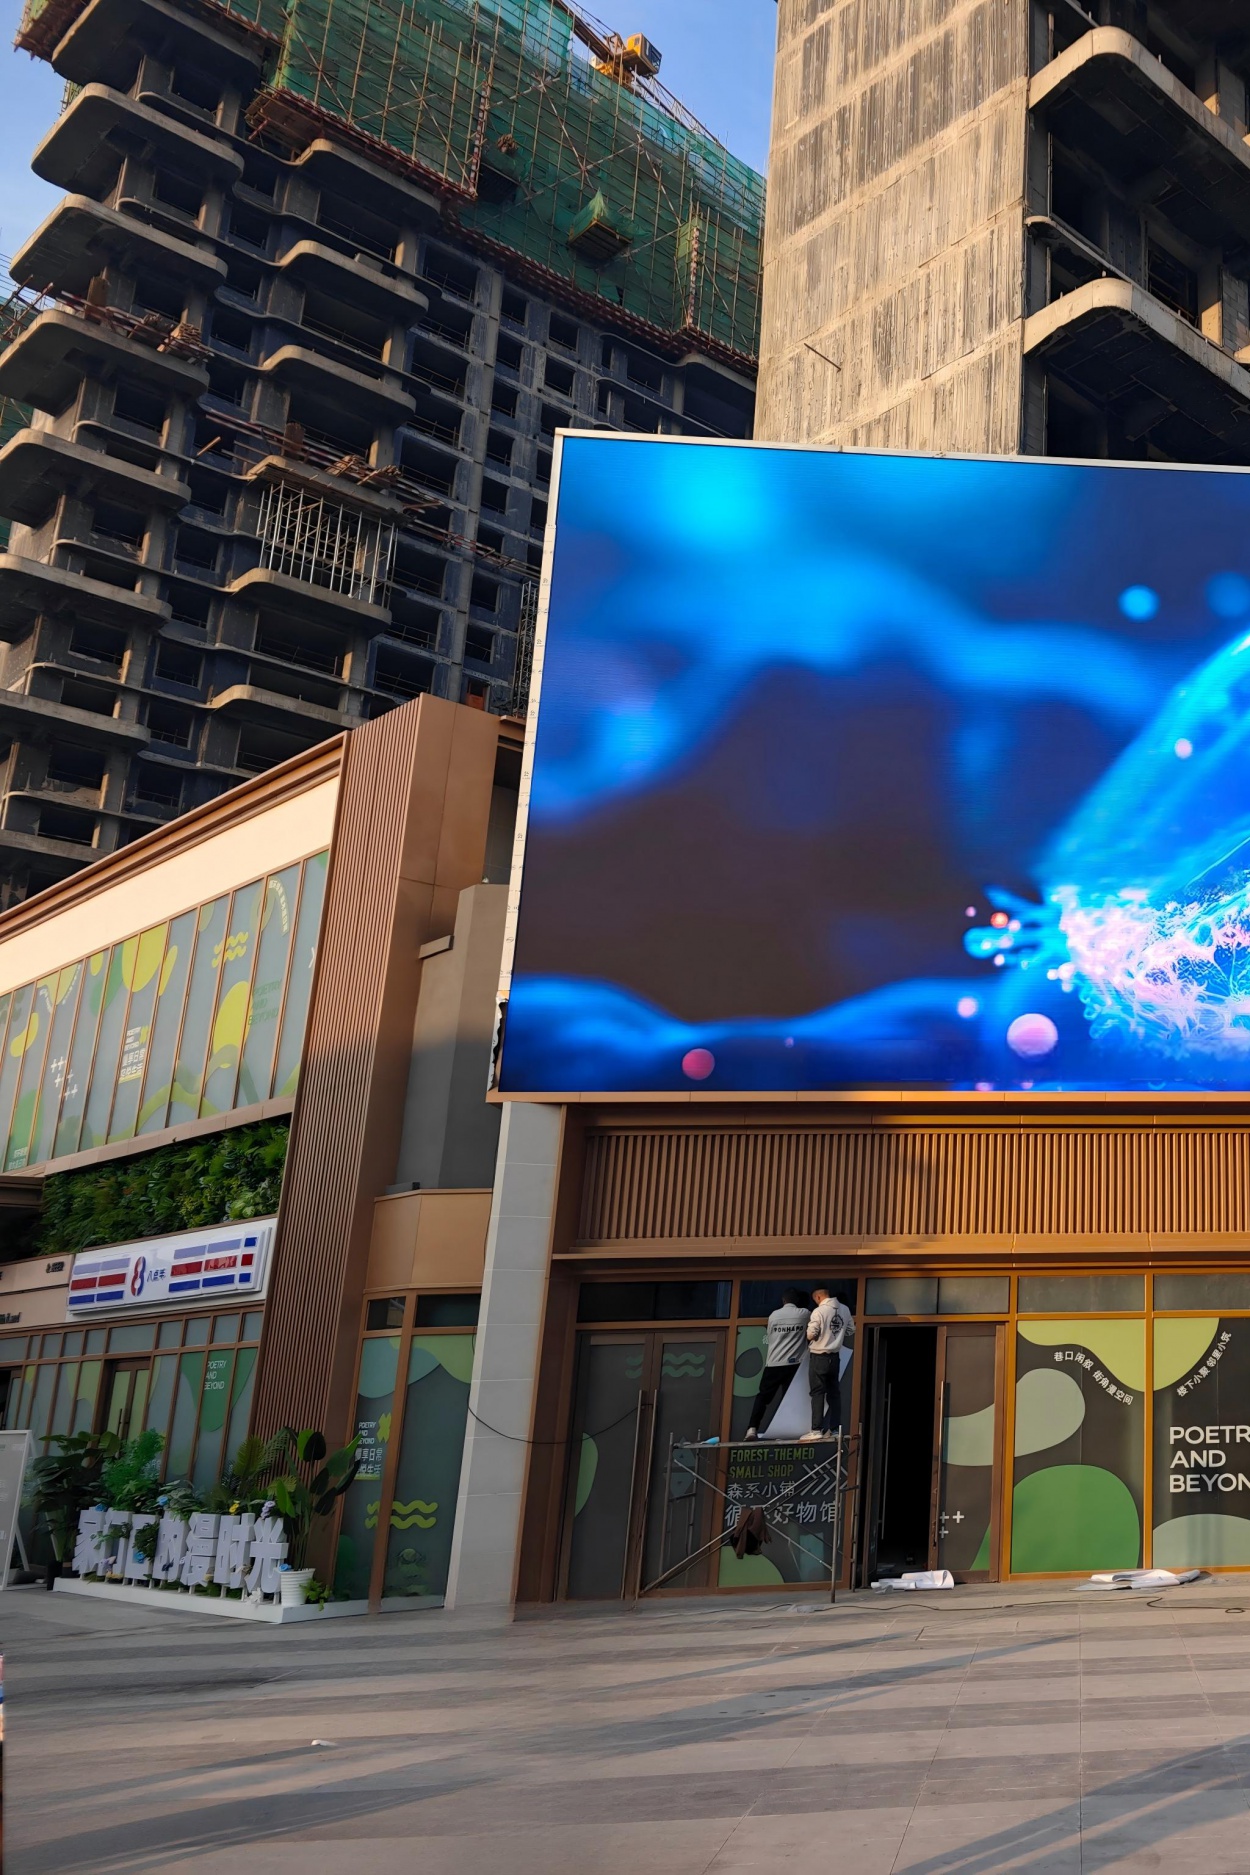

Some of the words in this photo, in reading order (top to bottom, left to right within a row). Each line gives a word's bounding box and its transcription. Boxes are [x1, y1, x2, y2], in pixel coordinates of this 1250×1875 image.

[358, 1437, 375, 1445] EYOND
[730, 1447, 815, 1463] FOREST-THEMED
[1169, 1450, 1227, 1469] AND
[729, 1466, 765, 1479] SMALL
[767, 1464, 794, 1478] SHOP
